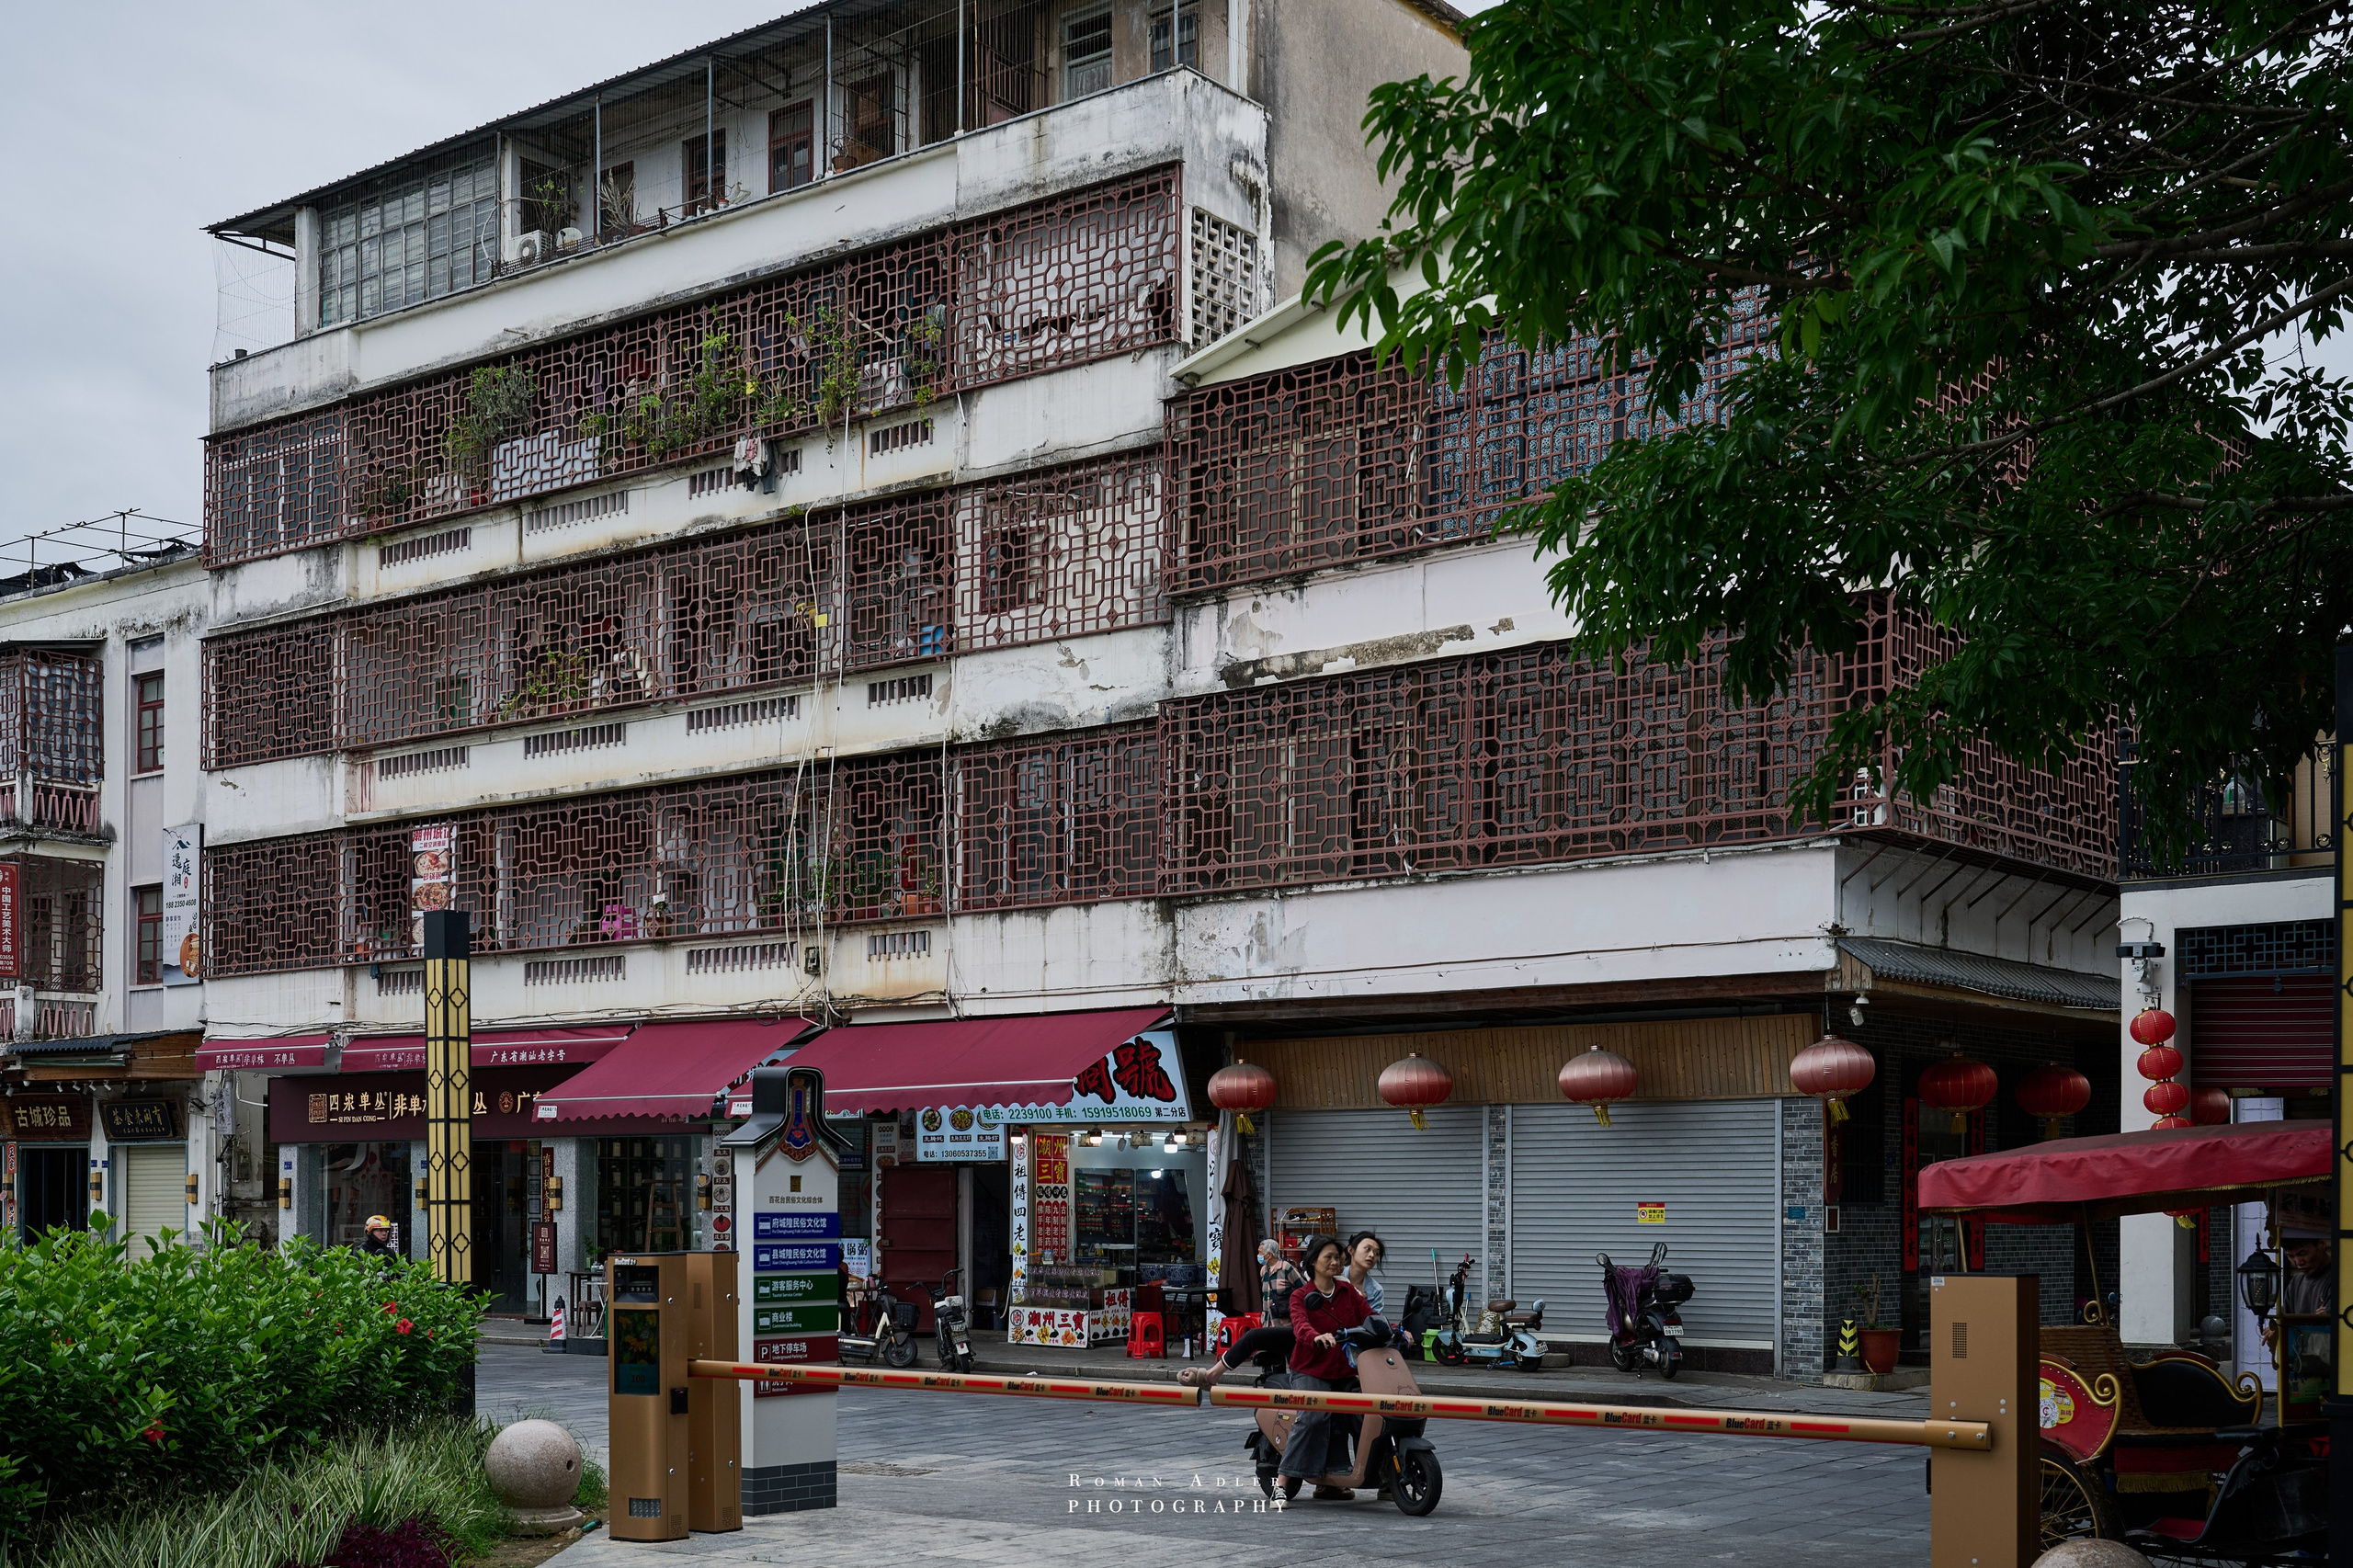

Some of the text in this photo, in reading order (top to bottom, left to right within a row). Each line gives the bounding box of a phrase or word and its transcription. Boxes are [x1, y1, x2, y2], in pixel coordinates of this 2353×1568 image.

[2, 886, 11, 952] 中国工艺美术大师
[490, 1049, 566, 1062] 广东省潮汕老字号
[472, 1092, 487, 1114] 丛
[15, 1106, 72, 1129] 古城珍品
[1009, 1108, 1051, 1119] 2239100
[1082, 1107, 1152, 1119] 15919518069
[1154, 1107, 1186, 1118] 第二分店
[941, 1149, 987, 1158] 13060537355
[1038, 1138, 1066, 1158] 潮州
[1038, 1161, 1066, 1184] 三寶
[768, 1196, 823, 1204] 百花台民俗文化综合体
[772, 1218, 827, 1228] 府城隍民俗文化馆
[772, 1248, 826, 1259] 县城隍民俗文化馆
[772, 1279, 813, 1290] 游客服务中心
[772, 1312, 792, 1323] 商业楼
[1029, 1311, 1084, 1332] 潮州三寶
[761, 1347, 768, 1358] P
[772, 1342, 807, 1355] 地下停车场
[768, 1368, 792, 1377] BlueCard
[845, 1372, 869, 1381] BlueCard
[925, 1377, 950, 1386] BlueCard
[1007, 1381, 1035, 1392] BlueCard
[1096, 1386, 1124, 1397] BlueCard
[1274, 1394, 1318, 1405] BlueCard 蓝卡
[1381, 1400, 1427, 1412] BlueCard 蓝卡
[1487, 1405, 1537, 1418] BlueCard 蓝卡
[1605, 1412, 1657, 1425] BlueCard 蓝卡
[1726, 1417, 1781, 1430] BlueCard 蓝卡
